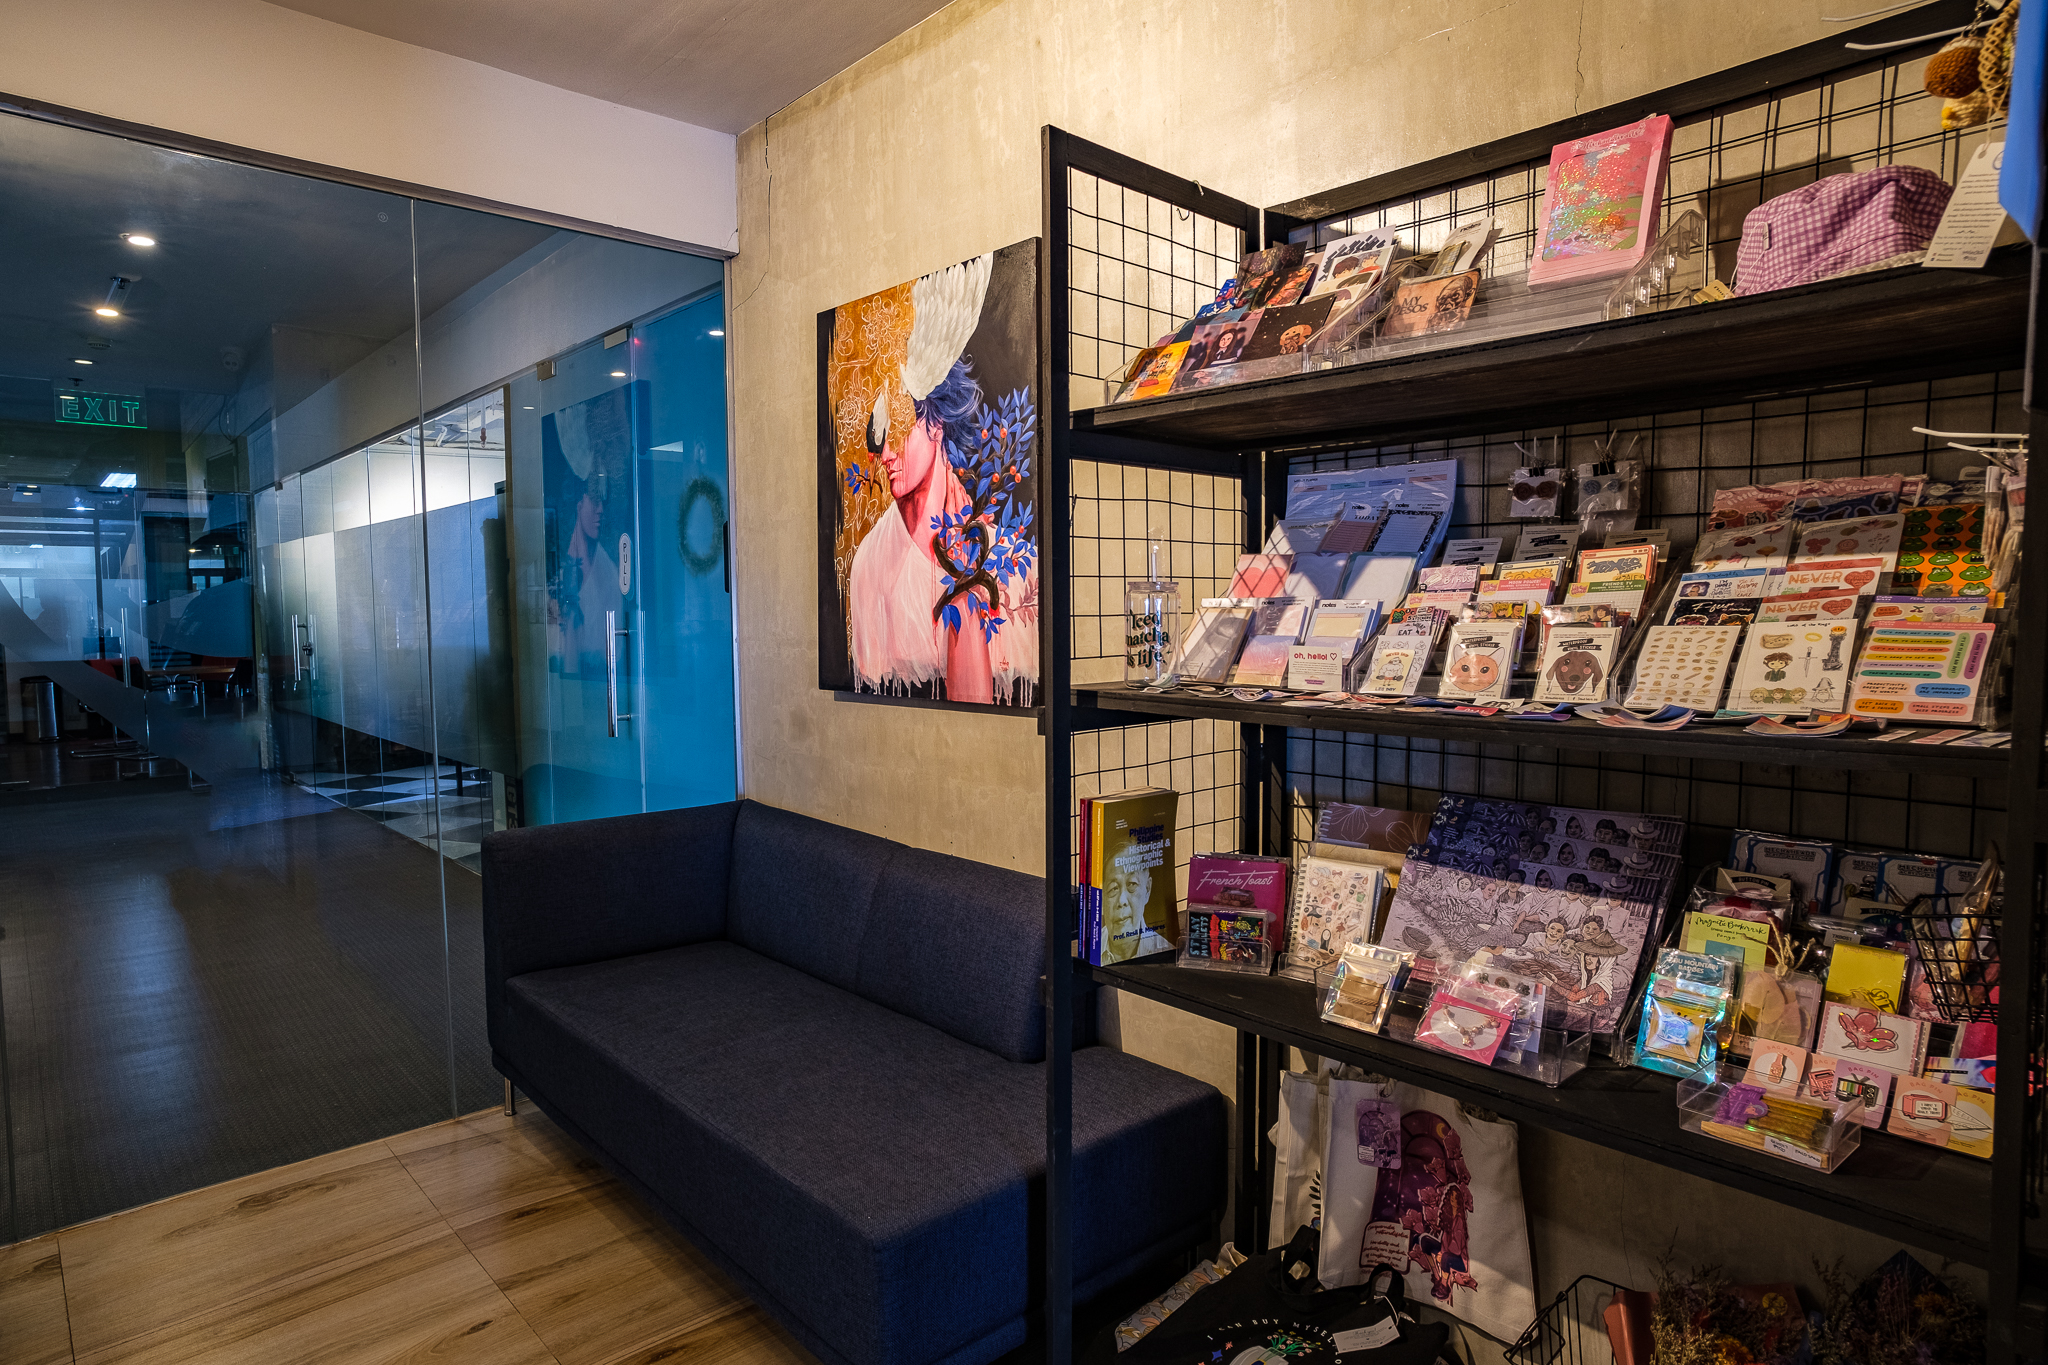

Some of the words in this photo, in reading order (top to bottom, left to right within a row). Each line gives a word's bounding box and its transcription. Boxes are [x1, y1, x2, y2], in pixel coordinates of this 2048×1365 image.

[1402, 296, 1422, 307] MY
[61, 396, 140, 424] EXIT
[1788, 571, 1843, 585] NEVER
[1764, 600, 1820, 614] NEVER
[1129, 823, 1164, 838] Philippine
[1137, 832, 1163, 844] Studies
[1128, 840, 1164, 854] Historical
[1164, 838, 1171, 846] &
[1114, 849, 1164, 868] Ethnographic
[1123, 858, 1164, 874] Viewpoints
[1196, 869, 1244, 890] French
[1228, 870, 1279, 889] Toast
[1113, 933, 1125, 941] Prof.
[1126, 930, 1138, 938] Resil
[1145, 924, 1165, 934] Mojares
[1190, 916, 1200, 956] STRAY
[1200, 916, 1208, 956] MULLETS
[1678, 965, 1704, 973] BADGES
[1684, 960, 1718, 970] MOUNTAIN
[1867, 1070, 1879, 1079] PIN
[1929, 1084, 1943, 1094] PIN
[1971, 1095, 1986, 1104] PIN
[1292, 1321, 1336, 1347] MYSEL
